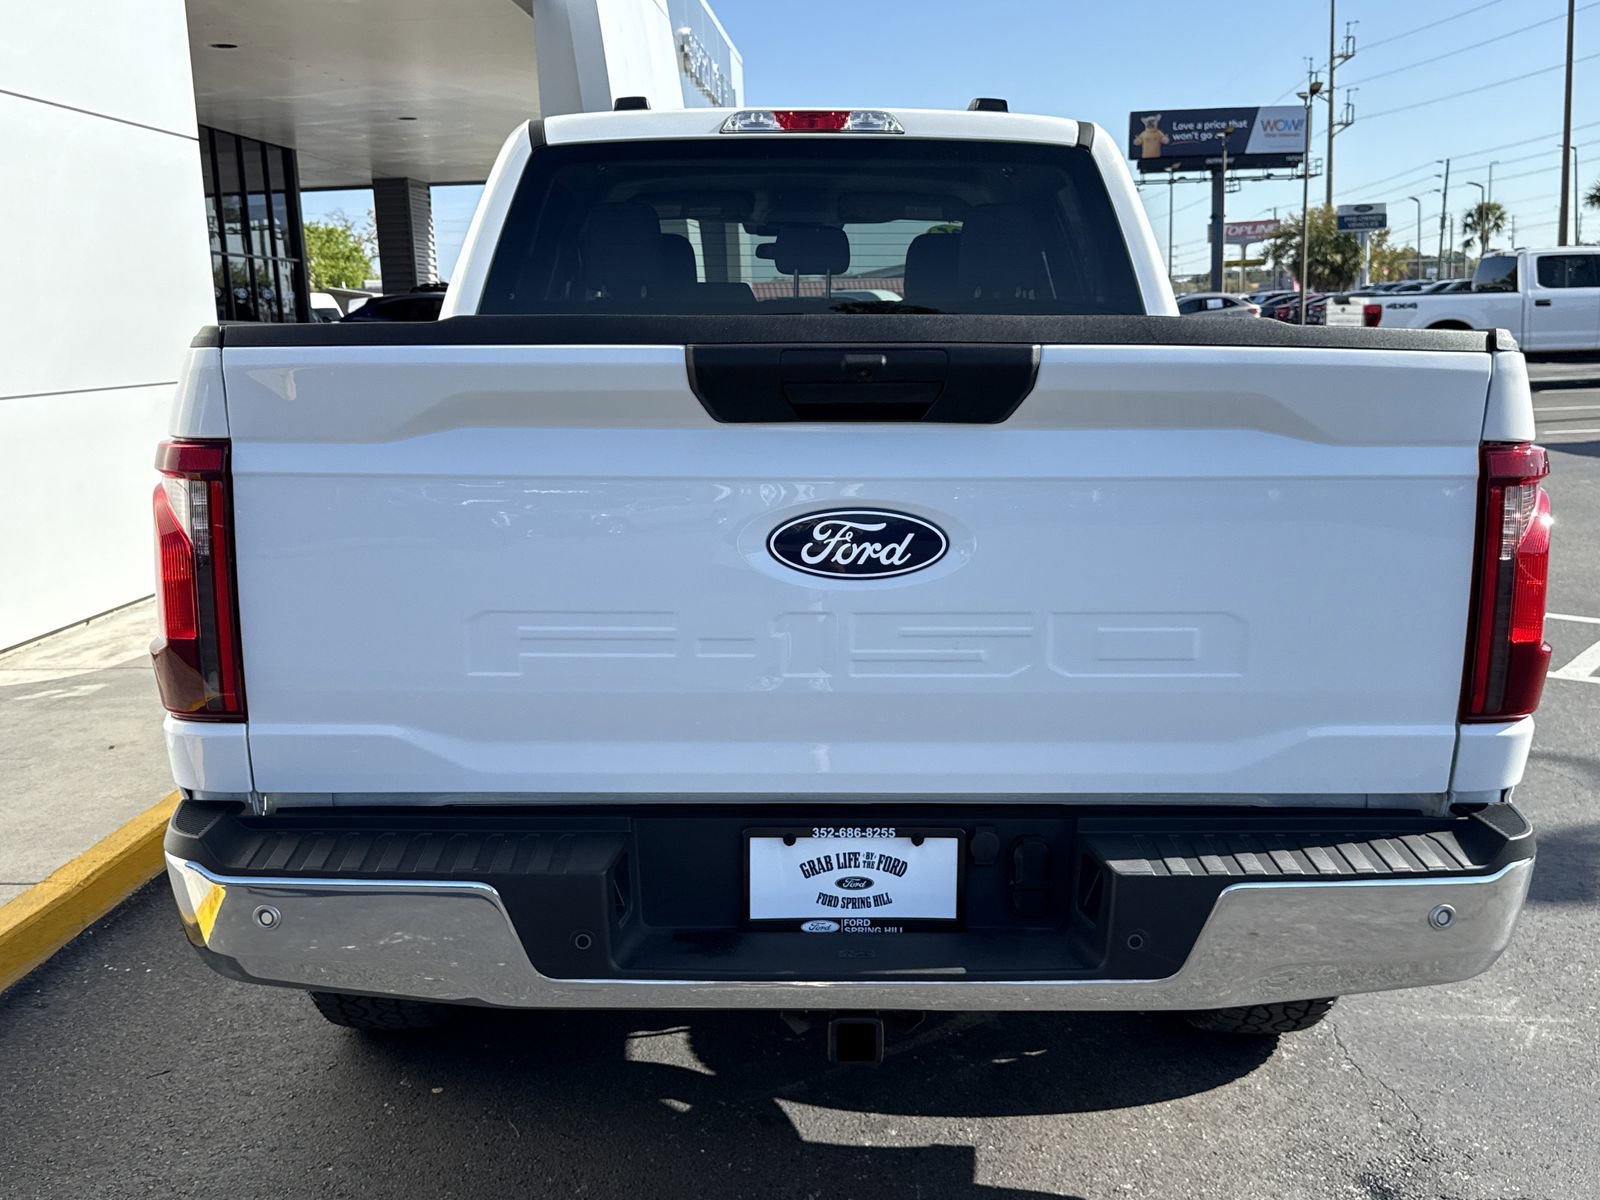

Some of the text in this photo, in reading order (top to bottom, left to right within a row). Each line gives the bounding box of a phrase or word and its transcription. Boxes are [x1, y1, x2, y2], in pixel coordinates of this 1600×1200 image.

[1172, 121, 1194, 131] Love
[1204, 120, 1226, 130] price
[1227, 119, 1248, 129] that
[1172, 131, 1198, 141] won't
[1200, 131, 1213, 142] go
[801, 520, 915, 565] Ford
[465, 610, 1246, 680] F-150
[812, 827, 896, 838] 352-686-8255
[799, 852, 908, 879] GRAB LIFE BY THE FORD
[842, 877, 867, 888] Ford
[816, 892, 893, 910] FORD SPRING HILL
[808, 921, 832, 931] Ford
[843, 918, 871, 927] FORD
